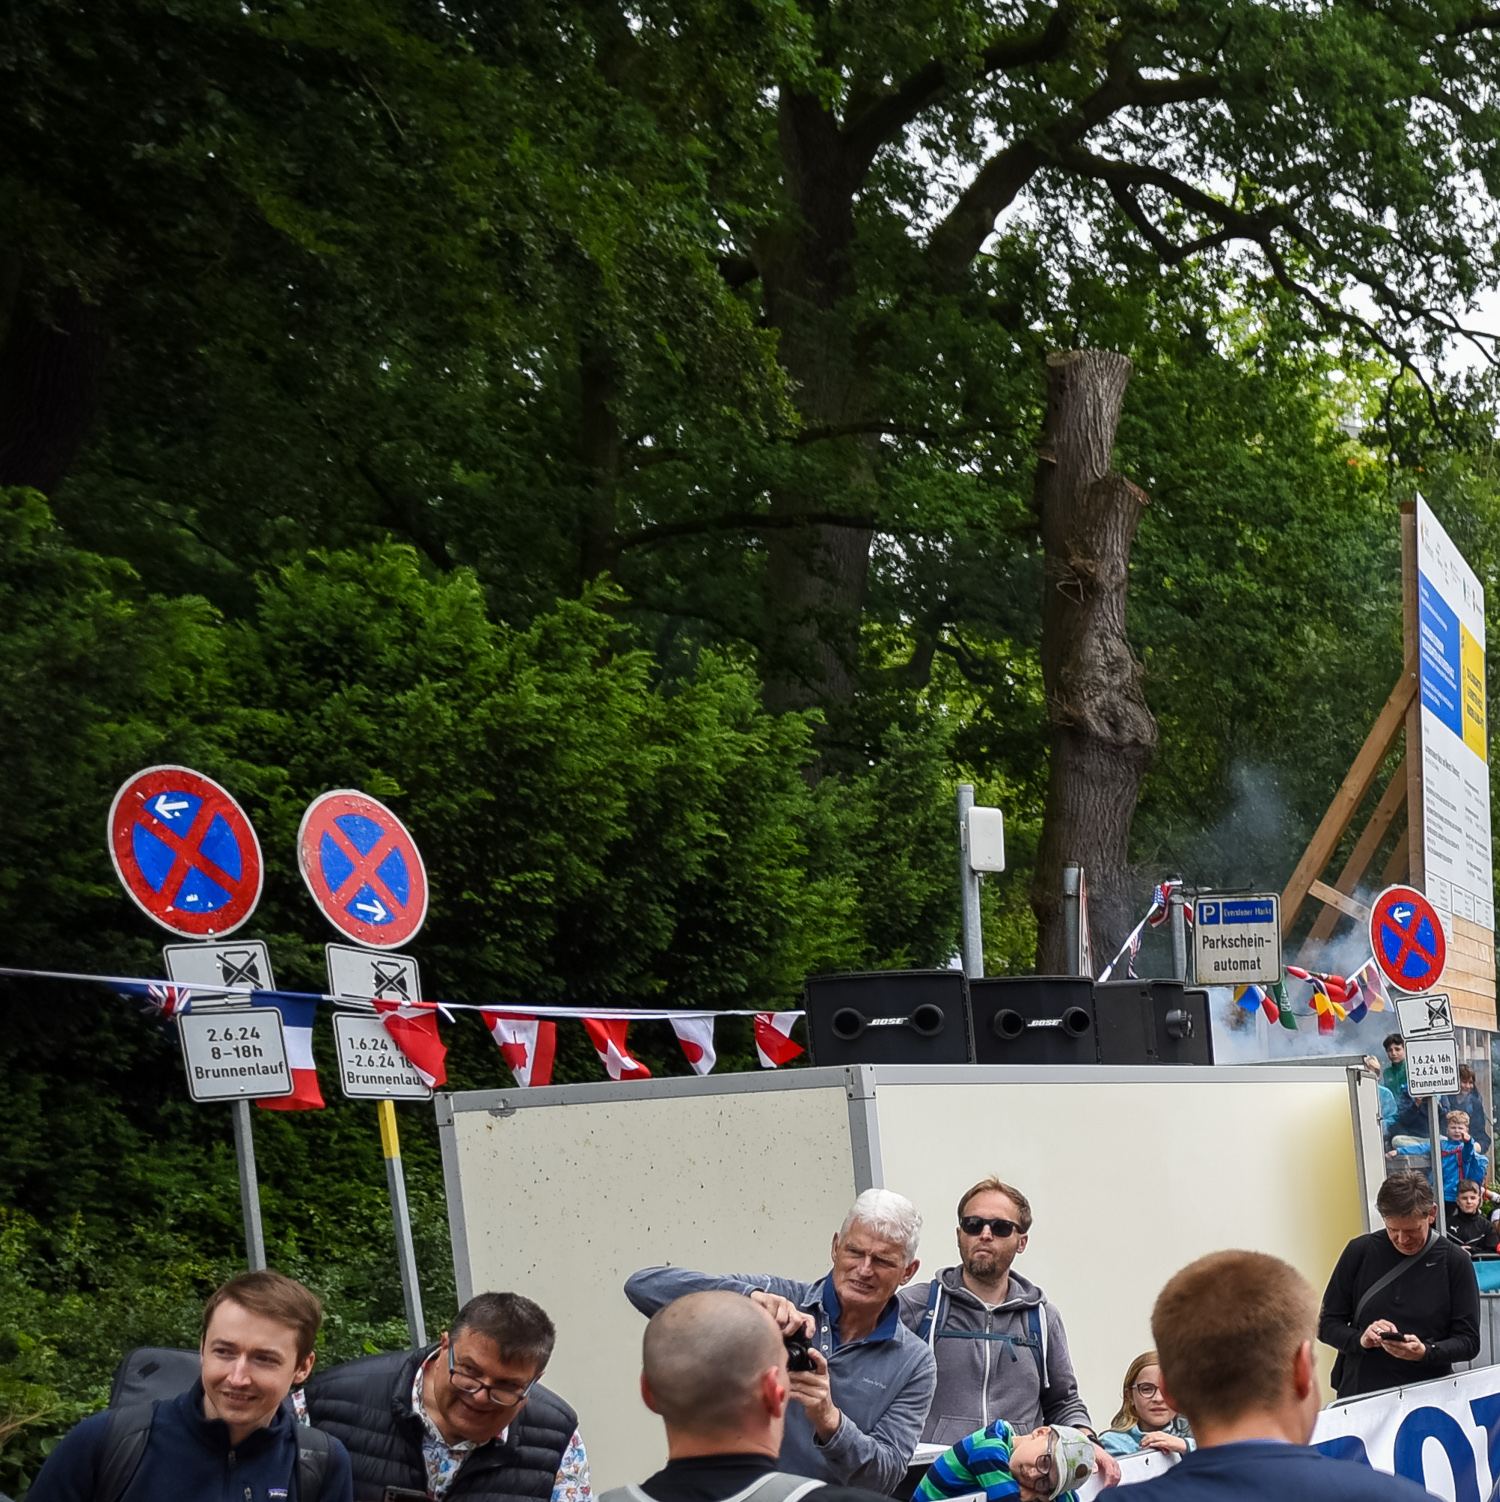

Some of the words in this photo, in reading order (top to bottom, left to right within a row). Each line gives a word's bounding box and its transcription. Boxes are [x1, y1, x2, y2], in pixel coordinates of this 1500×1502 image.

[1202, 934, 1271, 949] Parkschein-
[1214, 957, 1261, 971] automat
[867, 1018, 908, 1026] BOSE
[1027, 1019, 1062, 1027] BOSE
[207, 1027, 260, 1042] 2.6.24
[348, 1038, 388, 1051] 1.6.24
[211, 1045, 263, 1060] 8-18h
[1412, 1055, 1435, 1065] 1.6.24
[1438, 1054, 1451, 1063] 16h
[195, 1061, 283, 1080] Brunnenlauf
[1441, 1066, 1454, 1074] 18h
[347, 1072, 427, 1086] Brunnenlau
[1411, 1077, 1455, 1088] Brunnenlauf
